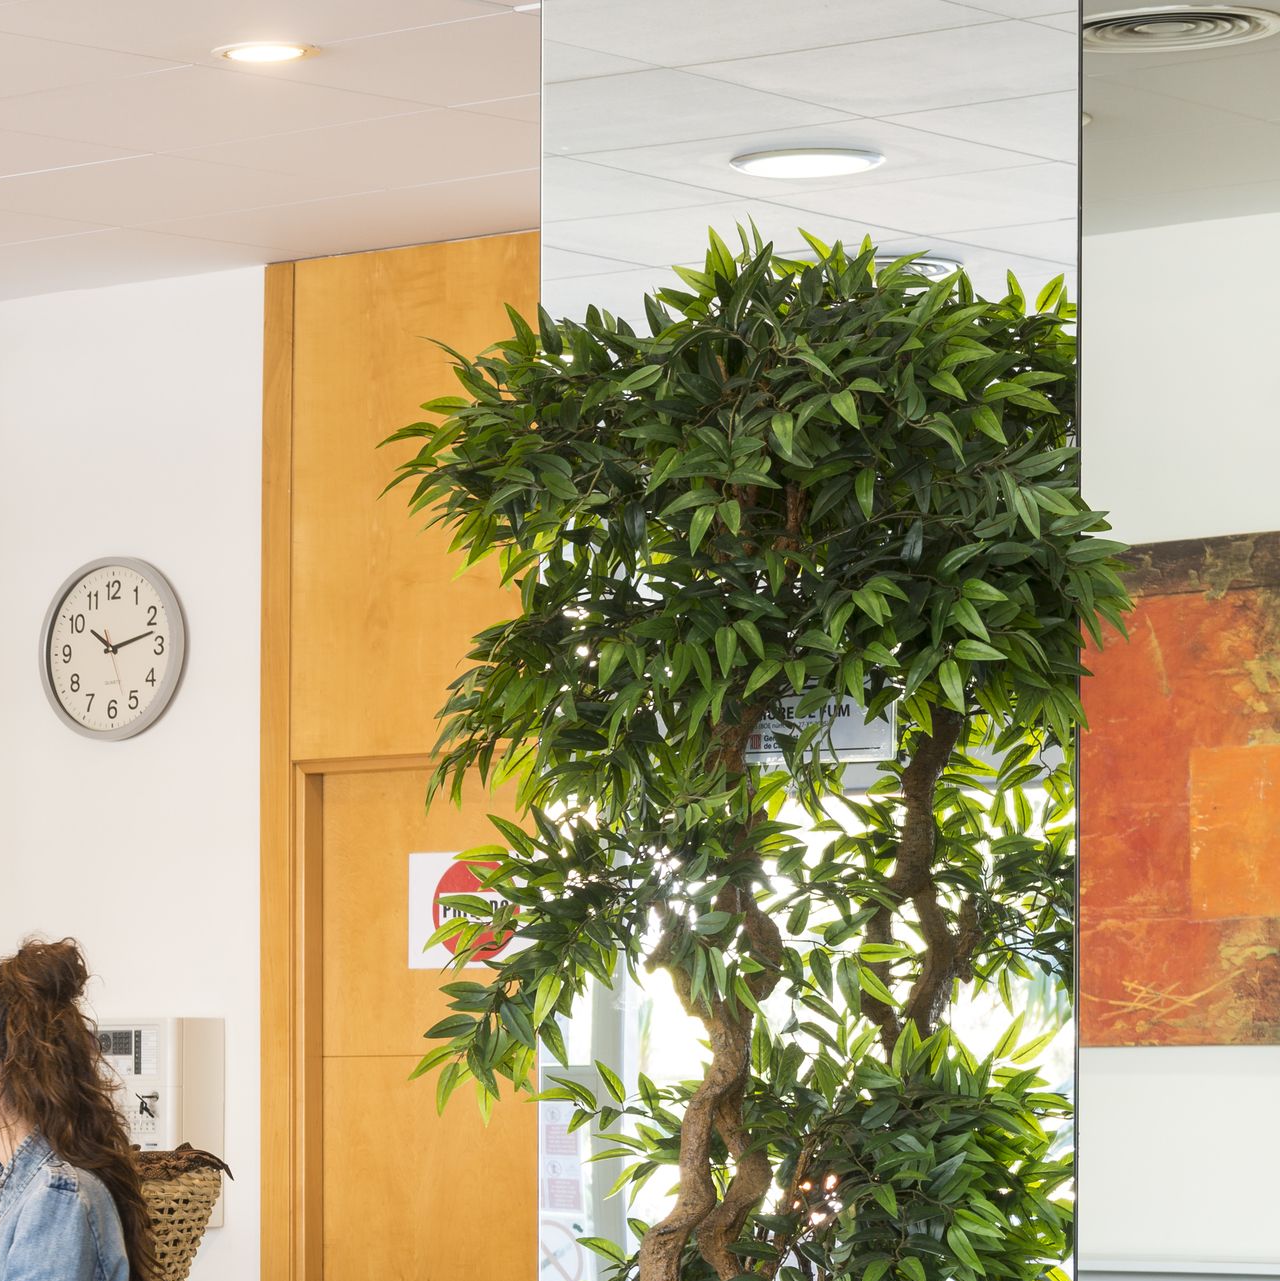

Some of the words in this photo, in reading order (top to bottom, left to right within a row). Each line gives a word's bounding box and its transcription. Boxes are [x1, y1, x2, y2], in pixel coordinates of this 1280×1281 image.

[106, 580, 121, 600] 12
[133, 586, 138, 605] 1
[87, 590, 98, 610] 11
[69, 614, 85, 634] 10
[147, 606, 157, 626] 2
[63, 644, 72, 663] 9
[153, 635, 164, 655] 3
[70, 673, 80, 692] 8
[146, 668, 156, 687] 4
[86, 693, 95, 712] 7
[107, 700, 117, 719] 6
[128, 690, 138, 710] 5
